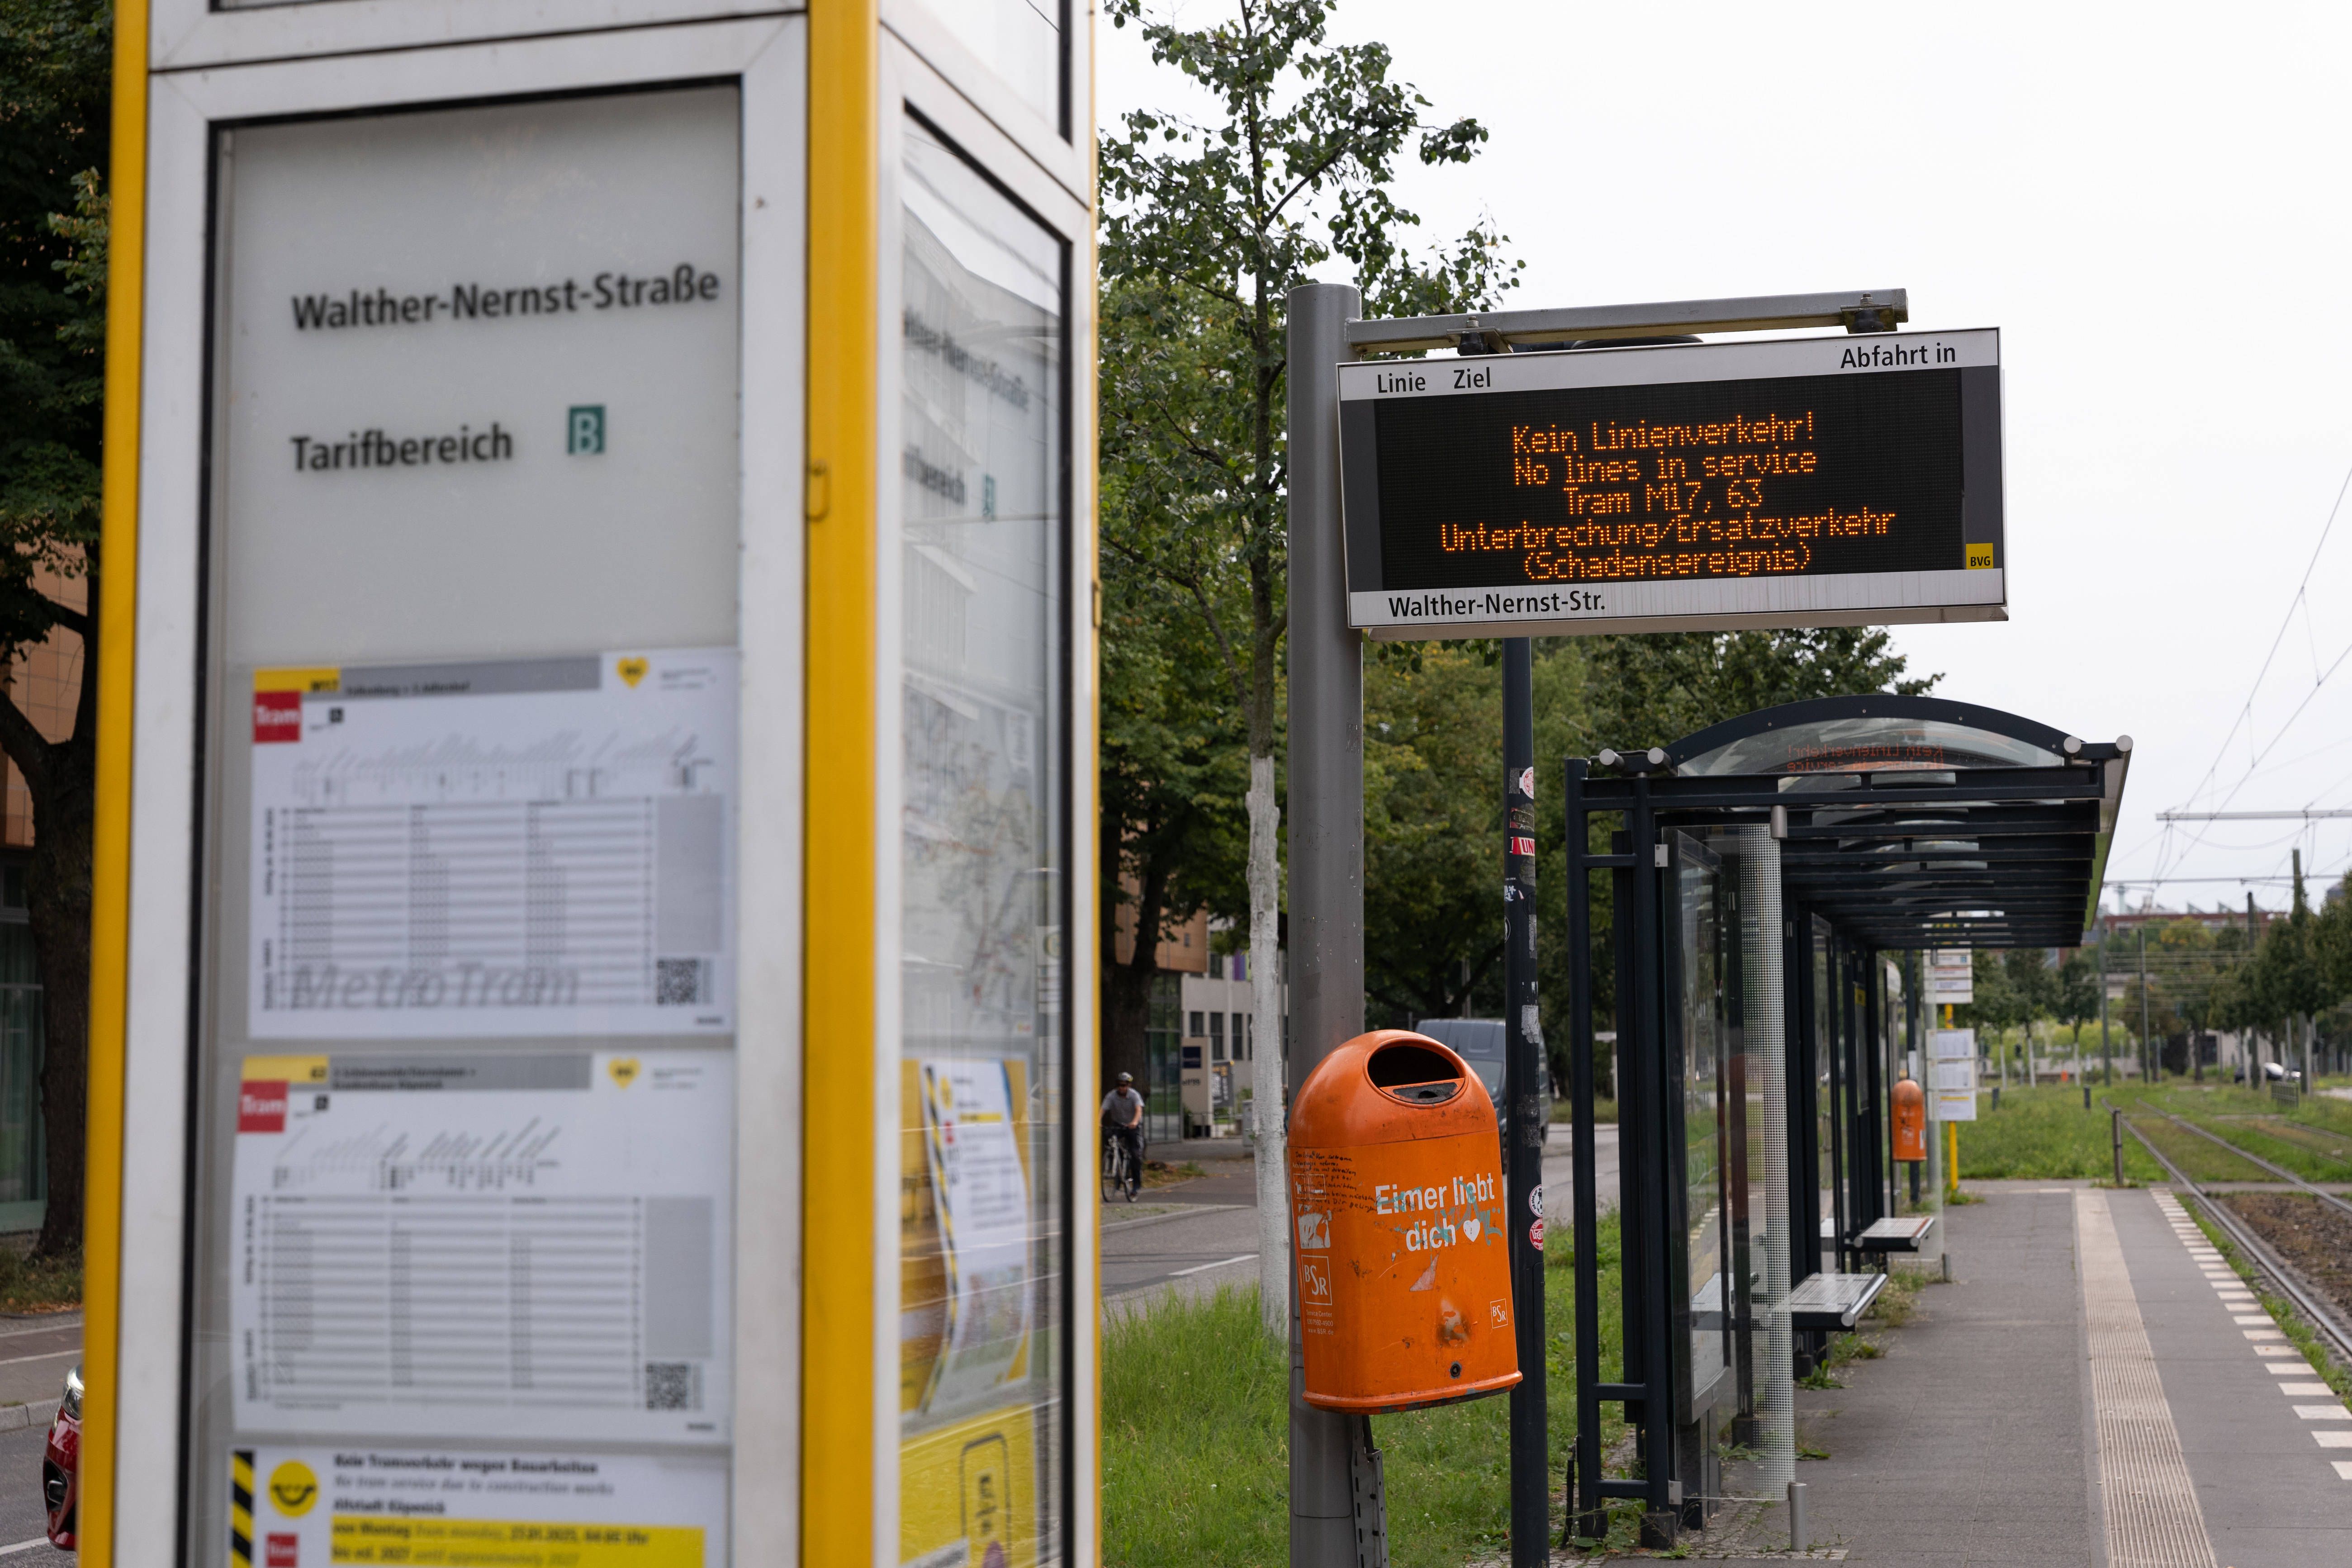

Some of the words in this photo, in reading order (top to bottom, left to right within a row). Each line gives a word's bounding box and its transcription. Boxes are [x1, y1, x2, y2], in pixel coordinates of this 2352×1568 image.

[292, 263, 720, 330] Walther-Nernst-Straße
[1840, 344, 1928, 369] Abfahrt
[1936, 342, 1955, 363] in
[1378, 372, 1426, 393] Linie
[1454, 366, 1491, 389] Ziel
[289, 422, 512, 471] Tarifbereich
[574, 412, 600, 453] B
[1513, 423, 1577, 453] Kein
[1593, 411, 1811, 450] Linienverkehr!
[1514, 457, 1549, 485] No
[1564, 454, 1641, 483] lines
[1657, 451, 1686, 479] in
[1703, 445, 1816, 477] service
[1563, 487, 1630, 514] Tram
[1646, 481, 1711, 512] M17,
[1728, 478, 1762, 508] 63
[1442, 507, 1896, 551] Unterbrechung/Ersatzverkehr
[1525, 542, 1810, 579] (Schadensereignis)
[1971, 556, 1990, 566] BVG
[1389, 590, 1605, 617] Walther-Nernst-Str.
[256, 706, 300, 724] Tram
[292, 962, 578, 1009] MetroTram
[242, 1094, 286, 1114] Tram
[1375, 1184, 1447, 1215] Eimer
[1453, 1173, 1494, 1205] liebt
[1406, 1218, 1456, 1251] dich
[1304, 1265, 1328, 1295] BSR
[1493, 1305, 1506, 1322] BSR
